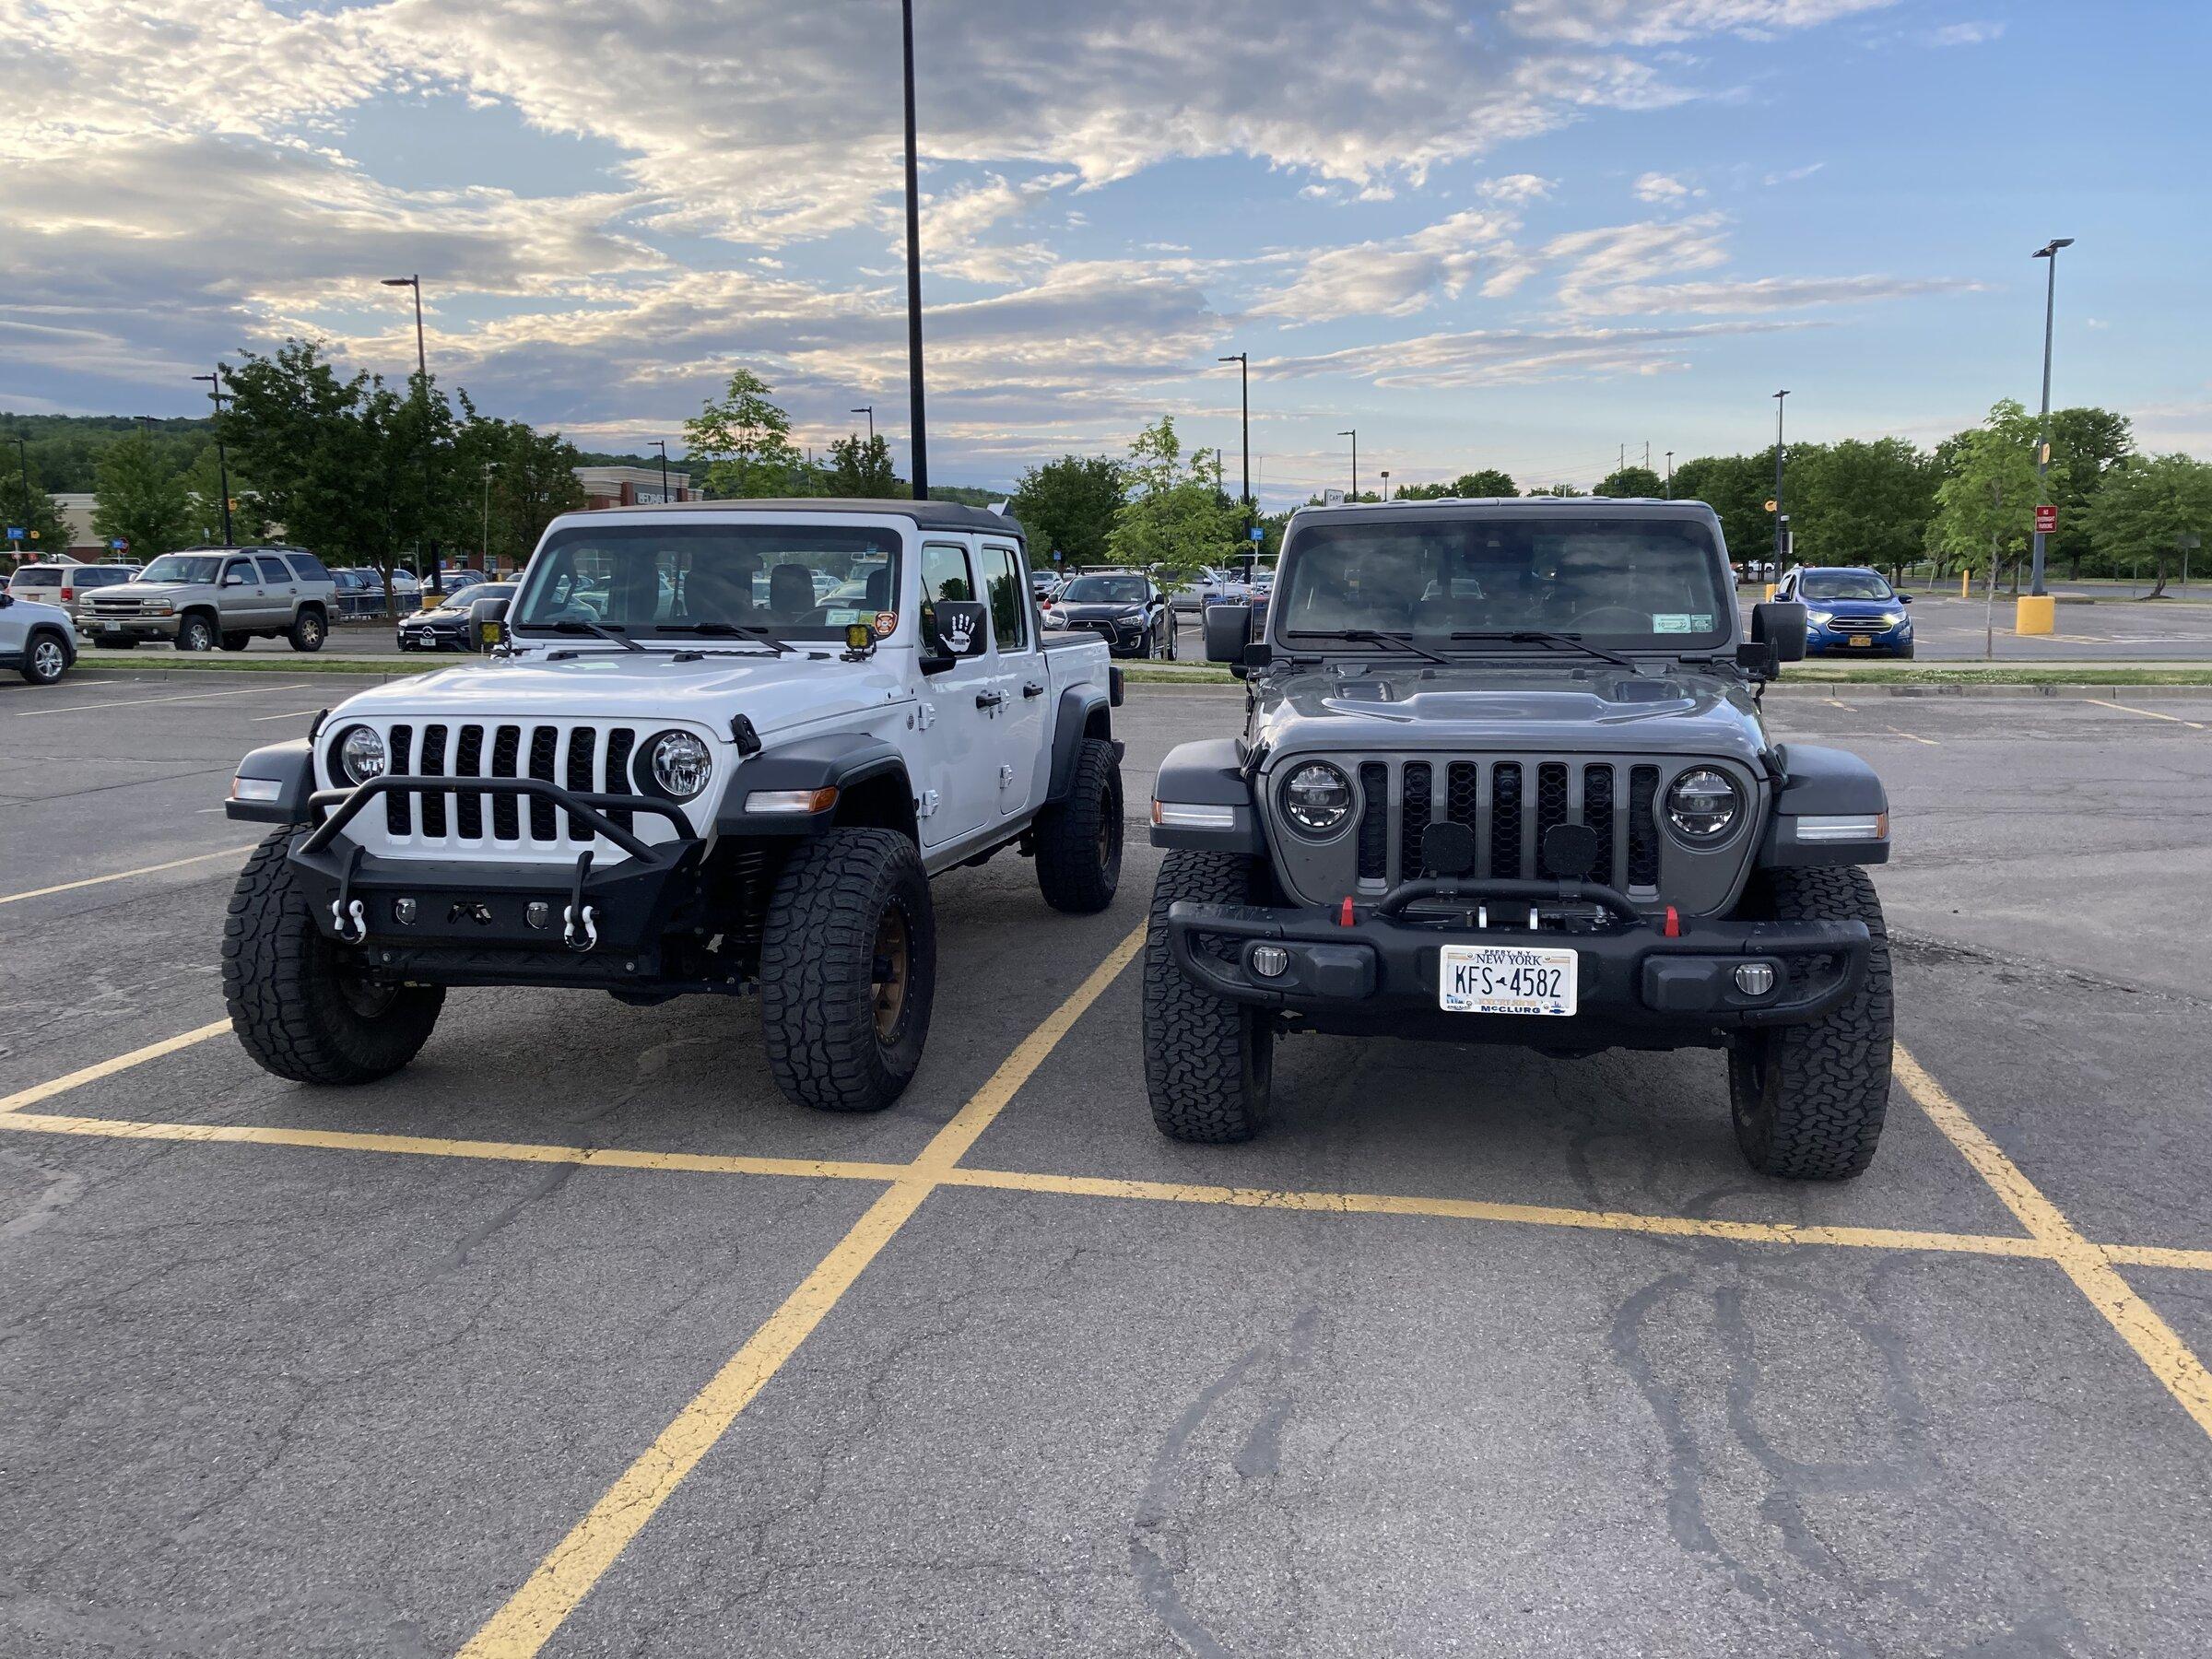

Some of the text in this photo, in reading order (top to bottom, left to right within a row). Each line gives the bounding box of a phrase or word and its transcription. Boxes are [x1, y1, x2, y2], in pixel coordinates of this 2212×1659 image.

[1329, 493, 1342, 502] CART
[1476, 954, 1542, 966] NEW YORK
